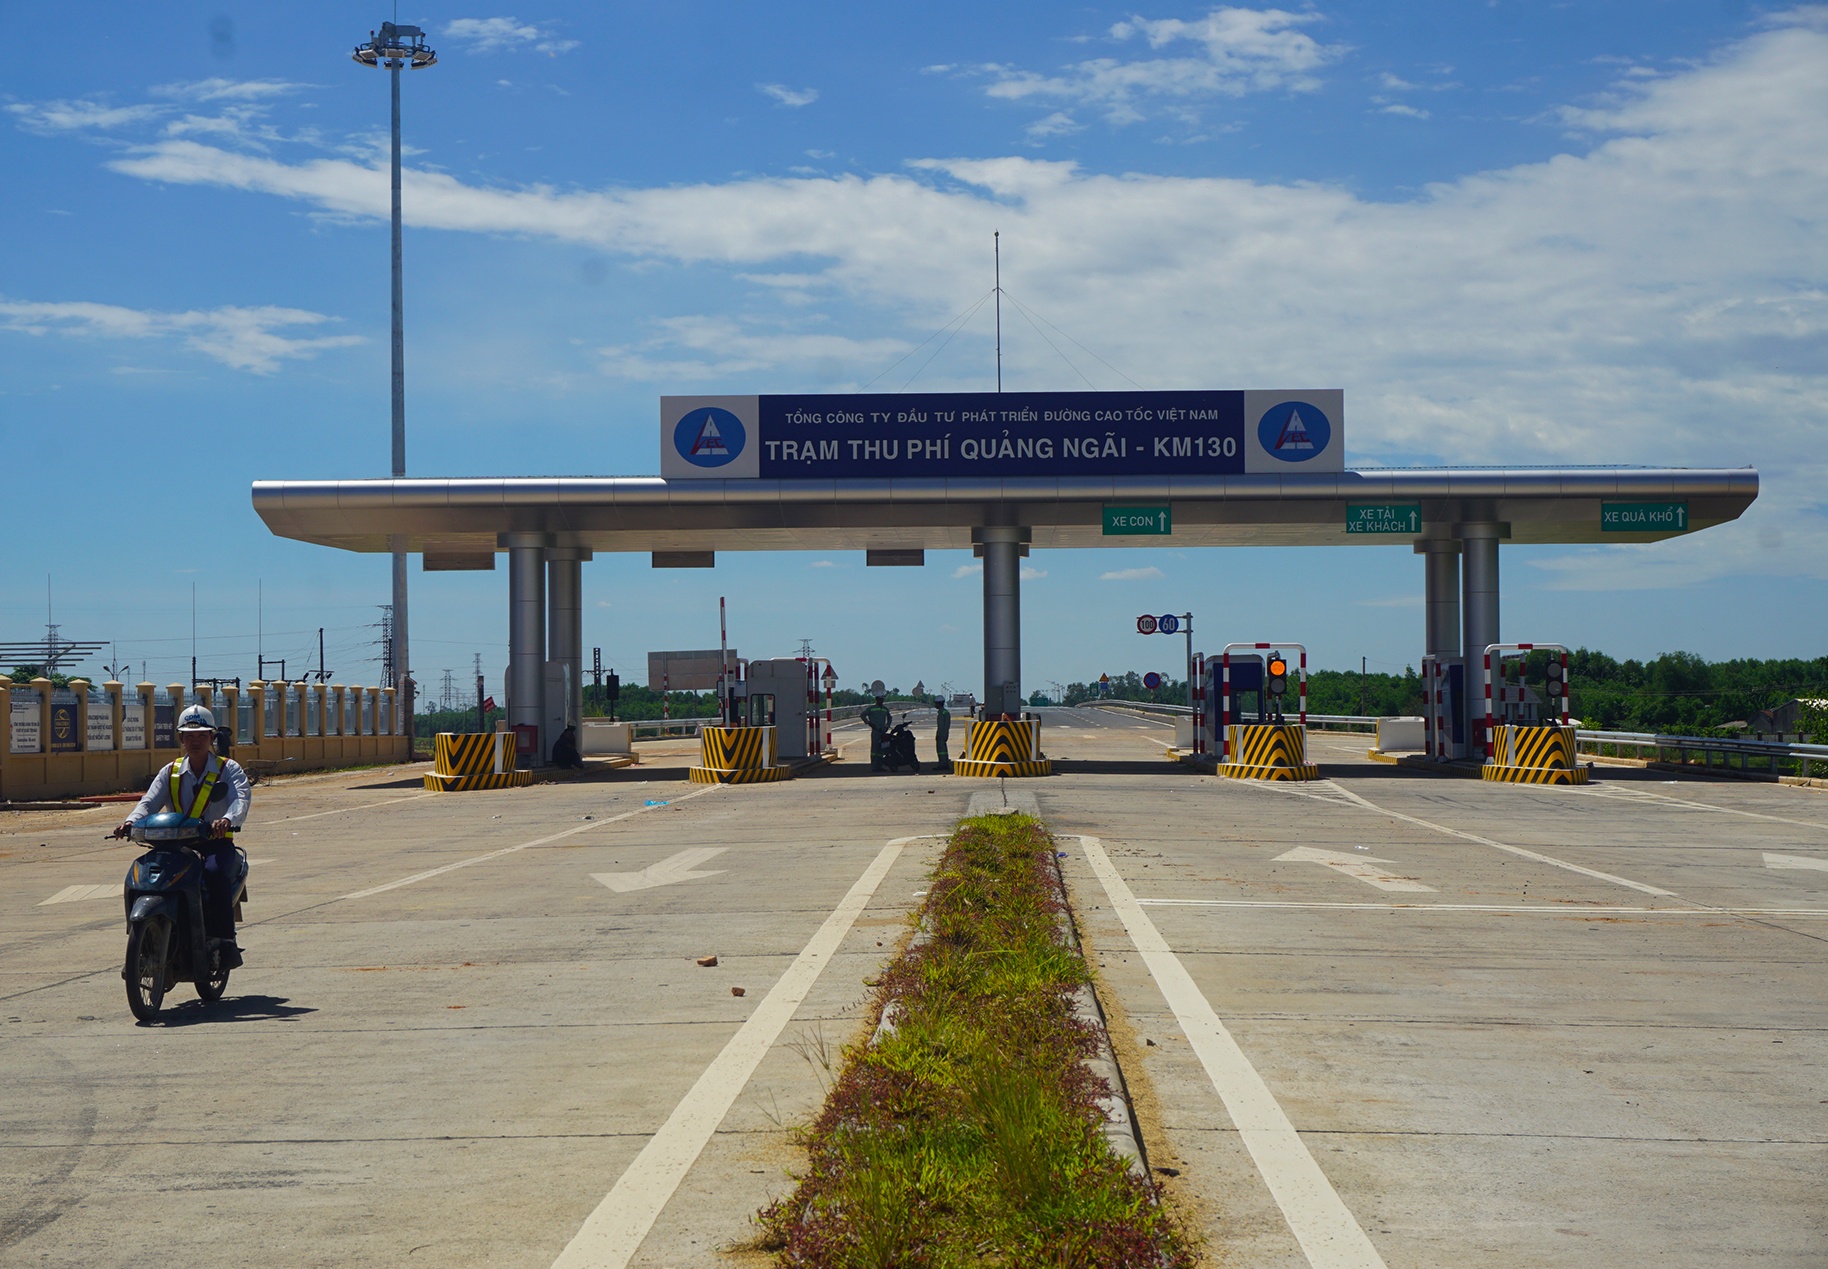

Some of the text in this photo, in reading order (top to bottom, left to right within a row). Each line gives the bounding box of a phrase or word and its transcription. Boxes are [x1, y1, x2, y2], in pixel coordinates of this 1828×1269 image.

[784, 406, 1219, 424] TỔNG CÔNG TY ĐẦU TƯ PHÁT TRIỂN ĐƯỜNG CAO TỐC VIỆT NAM
[765, 440, 839, 465] TRẠM
[847, 439, 899, 460] THU
[907, 433, 951, 460] PHÍ
[960, 429, 1054, 461] QUẢNG
[1063, 431, 1127, 459] NGÃI
[1153, 436, 1237, 458] KM130
[1359, 509, 1375, 520] XE
[1603, 506, 1674, 523] XE QUÁ KHỔ
[1112, 516, 1153, 527] XE CON
[1348, 519, 1406, 532] XE KHÁCH
[1141, 620, 1154, 630] 100
[1162, 618, 1175, 631] 60
